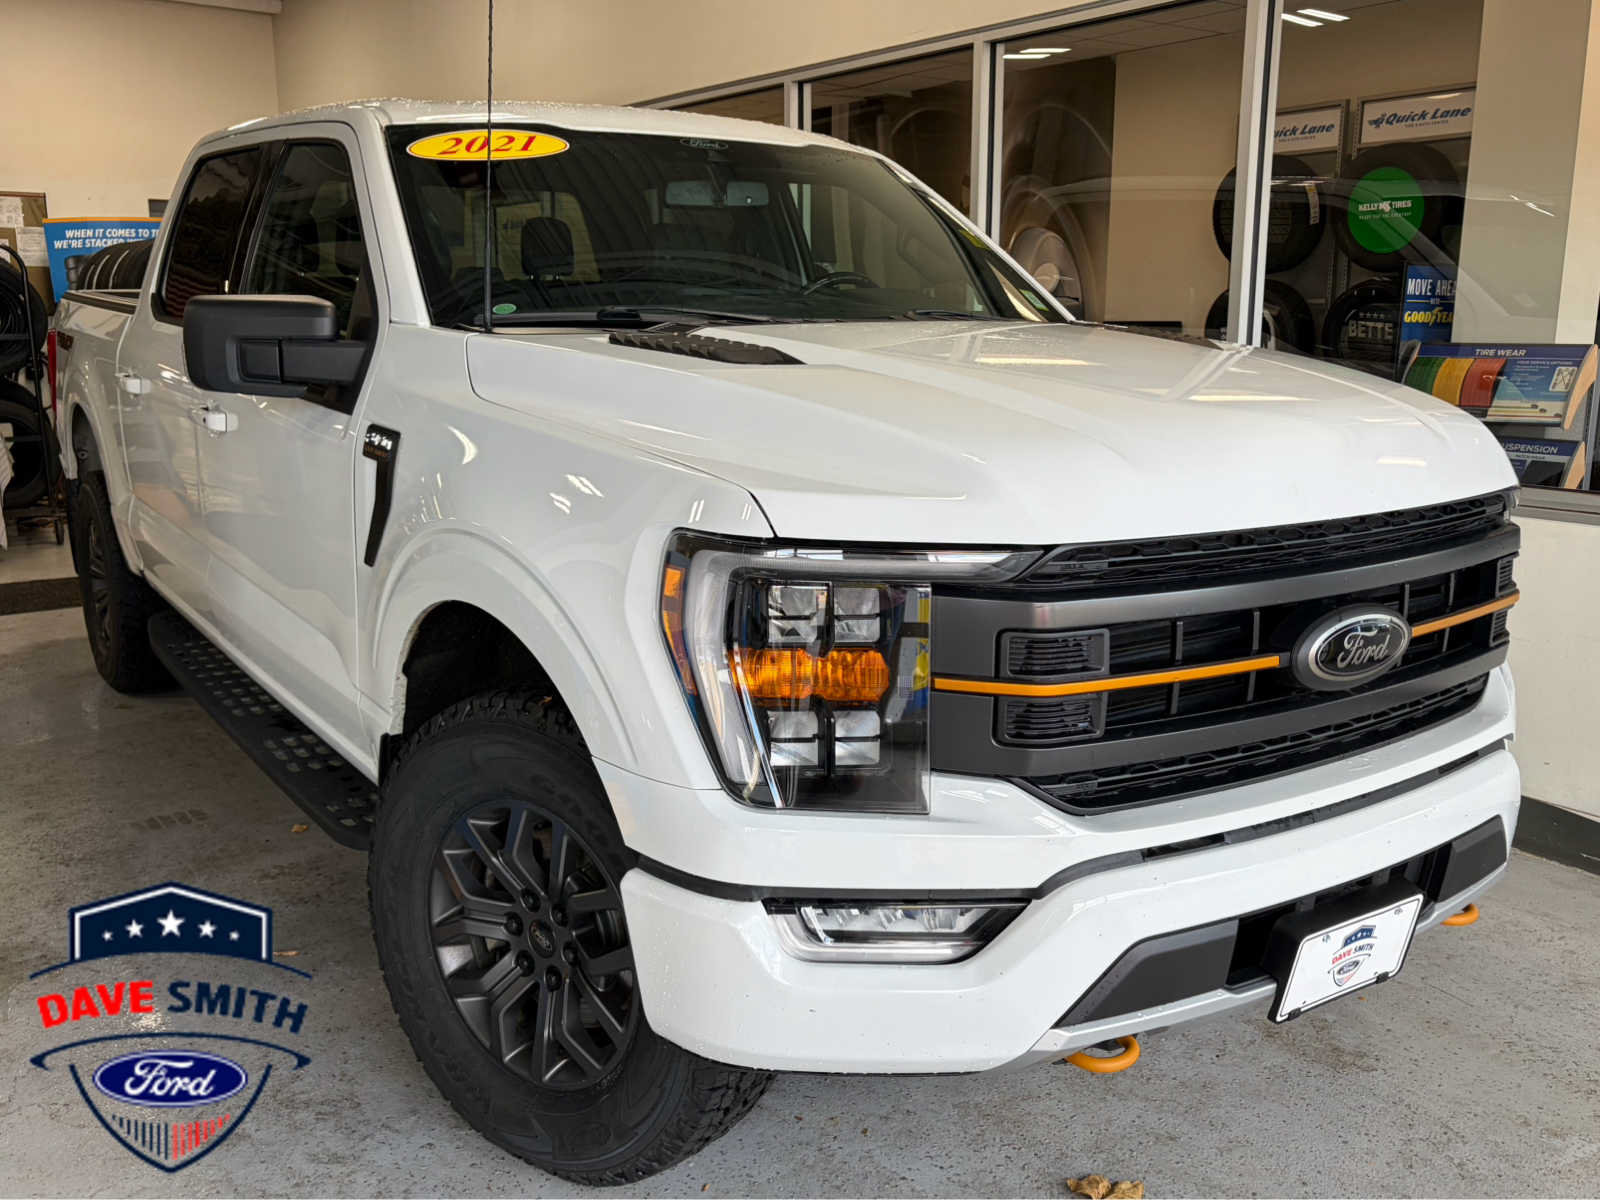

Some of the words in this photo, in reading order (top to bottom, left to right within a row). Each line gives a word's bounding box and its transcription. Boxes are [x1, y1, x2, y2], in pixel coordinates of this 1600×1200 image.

[1385, 110, 1428, 126] Quick
[1430, 106, 1472, 120] Lane
[1274, 124, 1298, 138] uick
[1300, 123, 1336, 136] Lane
[437, 135, 537, 155] 2021
[65, 228, 93, 239] WHEN
[95, 228, 105, 238] IT
[105, 228, 136, 238] COMES
[138, 229, 150, 238] TO
[54, 239, 83, 249] WE'RE
[1407, 278, 1433, 296] MOVE
[1475, 348, 1496, 357] TIRE
[1497, 348, 1528, 357] WEAR
[1503, 443, 1559, 455] USPENSION
[1337, 629, 1390, 668] Ford
